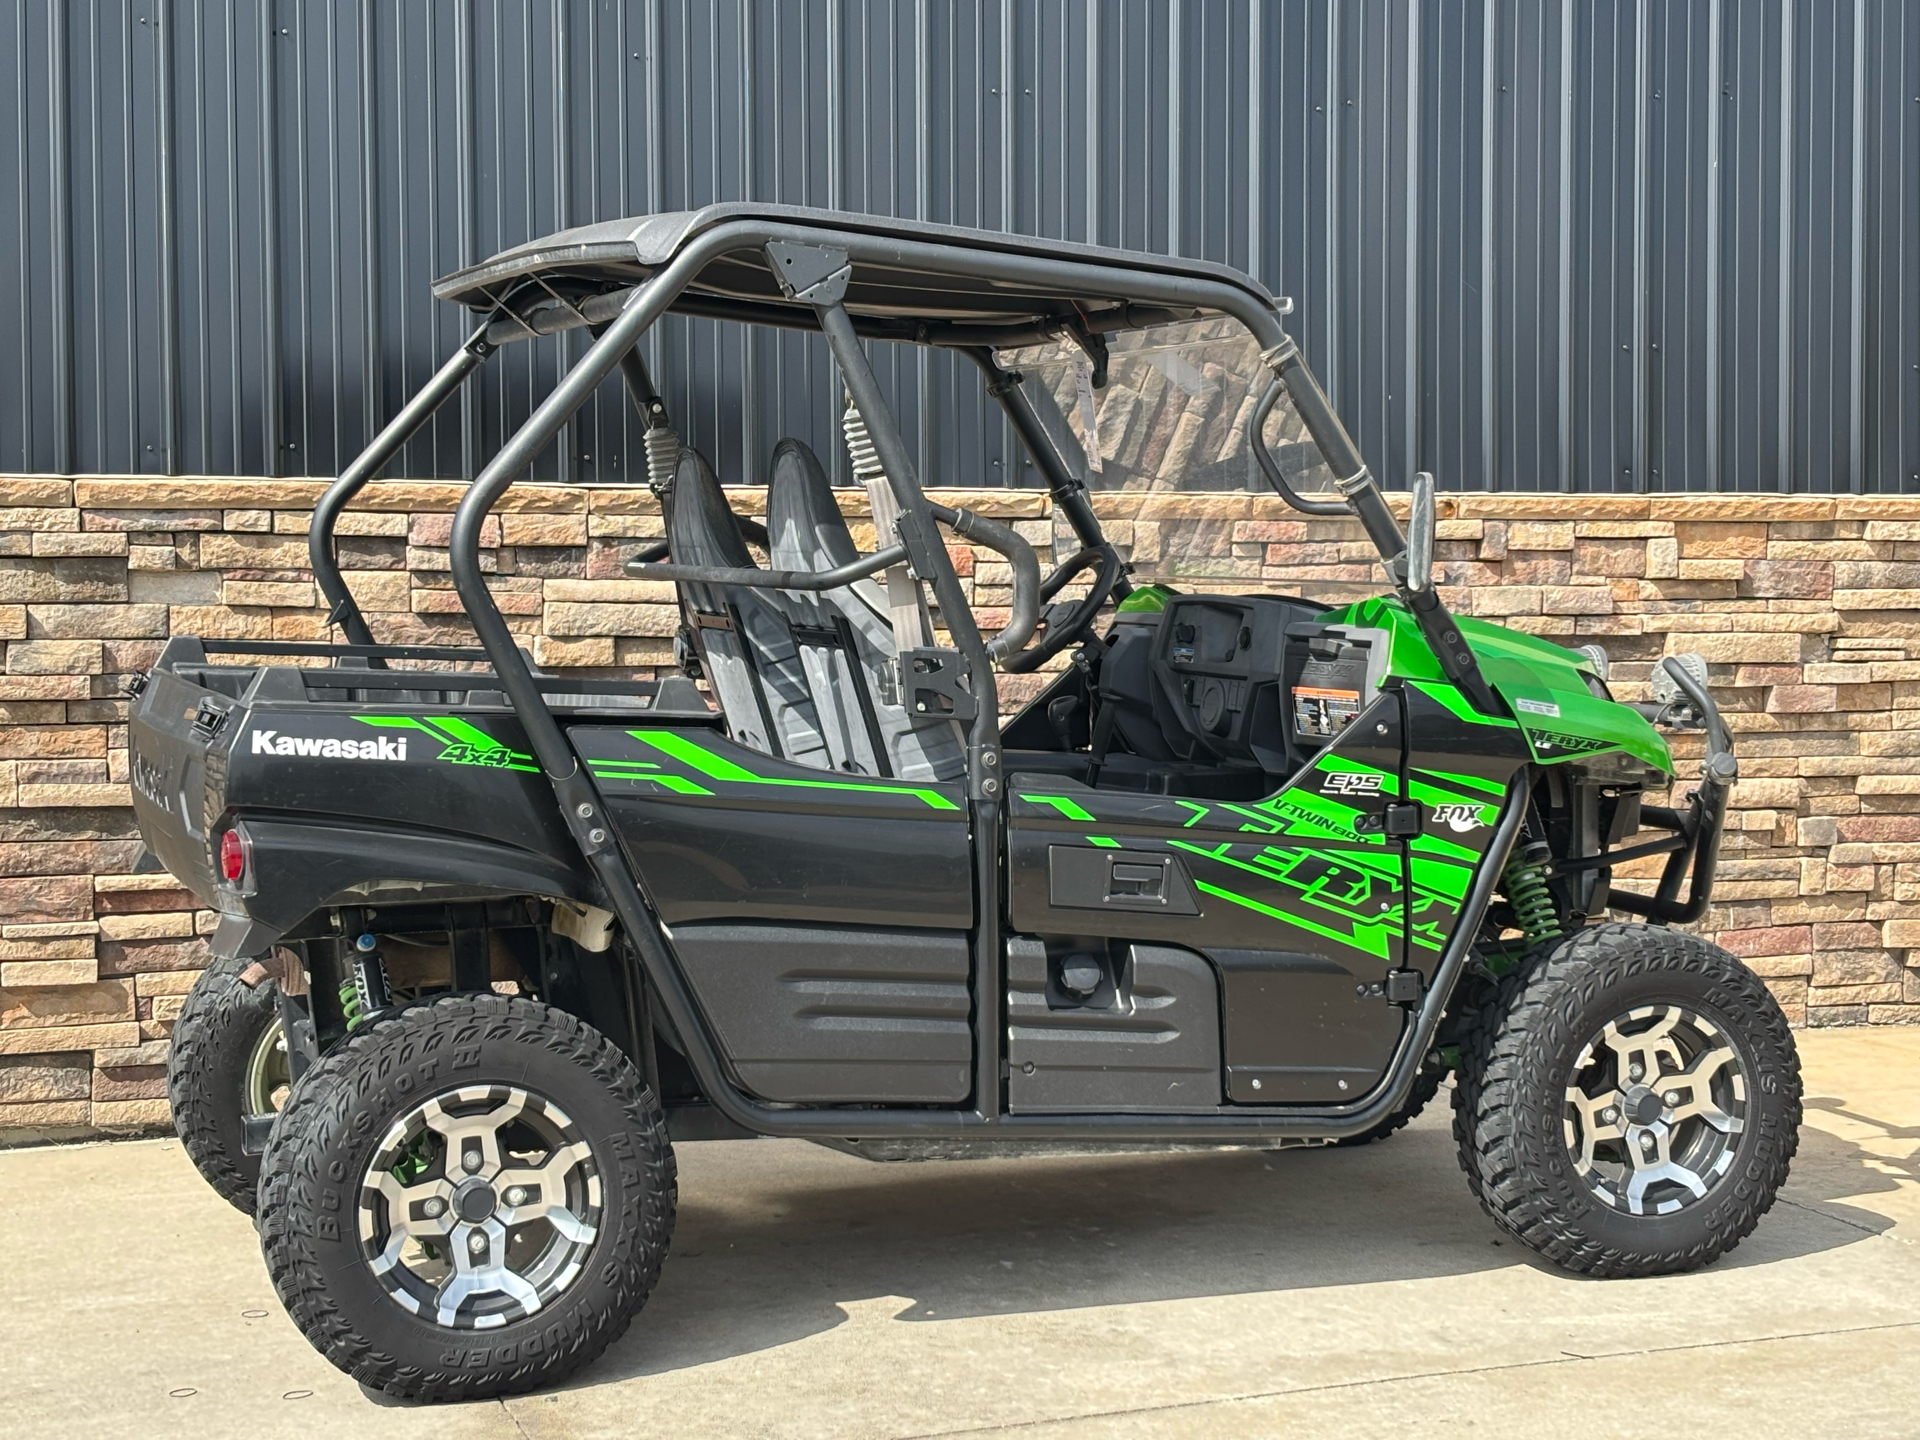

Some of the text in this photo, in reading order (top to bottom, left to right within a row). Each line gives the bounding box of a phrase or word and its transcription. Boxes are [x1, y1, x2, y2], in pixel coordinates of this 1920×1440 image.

[251, 730, 407, 761] Kawasaki
[437, 743, 511, 768] 4x4
[1531, 729, 1602, 751] TERYX
[1534, 741, 1552, 749] LE
[1323, 772, 1385, 792] EPS
[1431, 803, 1486, 829] FOX
[1702, 986, 1777, 1096] MAXXIS
[316, 1057, 439, 1243] BUCKSHOT
[1702, 1112, 1777, 1232] MUDDER
[600, 1130, 640, 1288] MAXXIS
[439, 1297, 597, 1369] MUDDER
